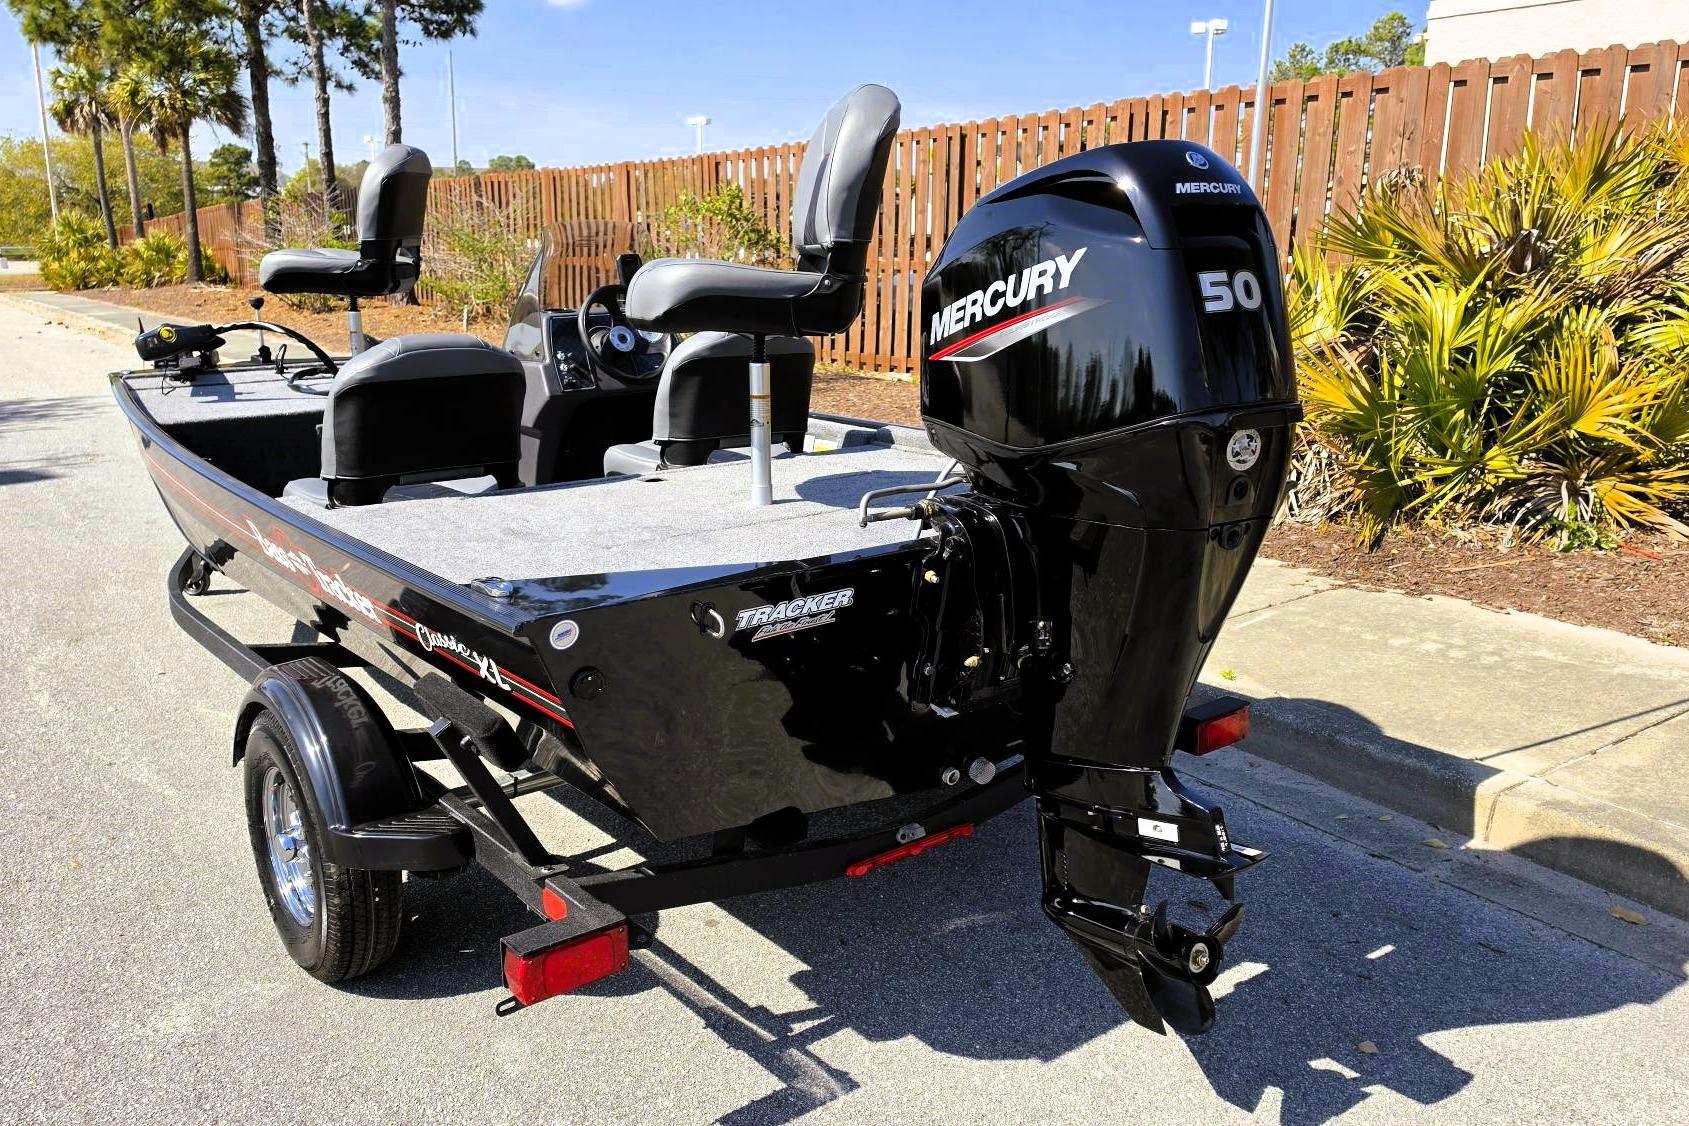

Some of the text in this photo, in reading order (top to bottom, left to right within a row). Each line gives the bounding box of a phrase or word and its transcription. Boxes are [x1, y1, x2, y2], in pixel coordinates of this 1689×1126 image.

[1175, 182, 1241, 194] MERCURY
[930, 247, 1087, 345] MERCURY
[1198, 270, 1262, 313] 50
[736, 588, 855, 631] TRACKER
[416, 622, 512, 691] Classic XL
